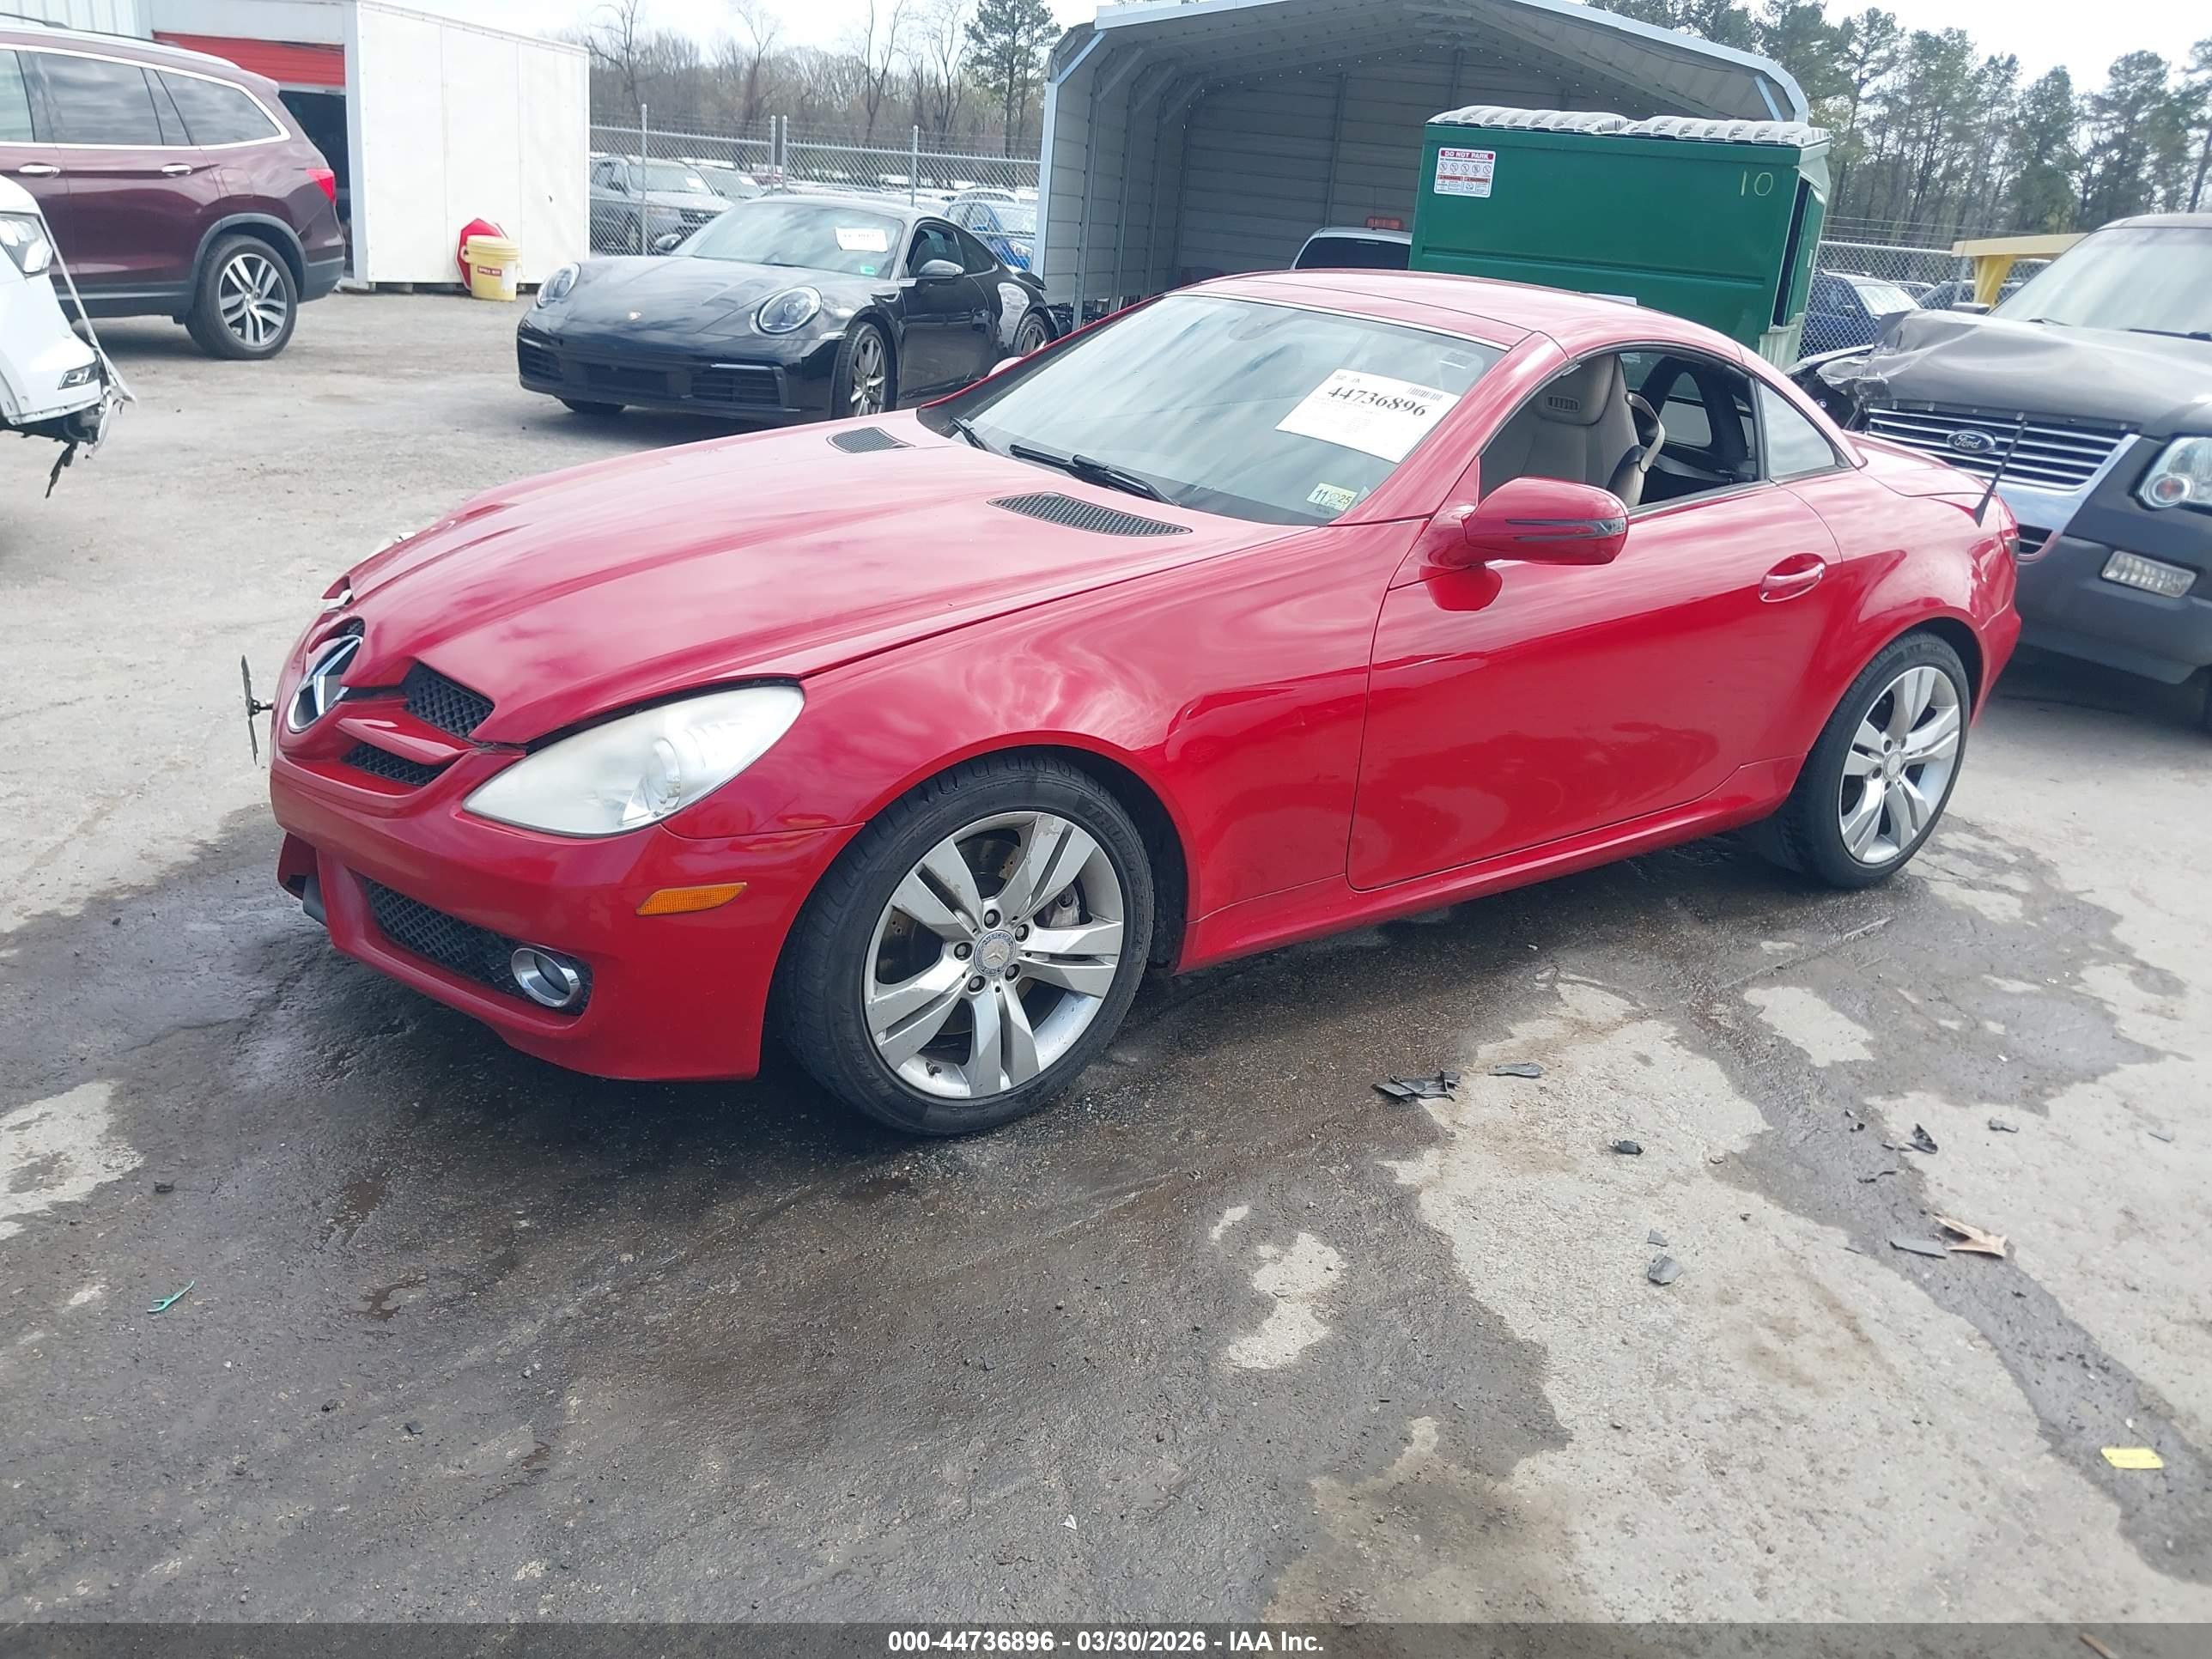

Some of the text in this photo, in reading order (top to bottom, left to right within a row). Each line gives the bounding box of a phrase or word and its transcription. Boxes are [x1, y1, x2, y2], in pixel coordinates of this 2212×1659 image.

[1741, 171, 1773, 196] 10
[1328, 386, 1430, 416] 44736896
[1954, 434, 1982, 448] Ford
[1314, 489, 1352, 505] 11 25
